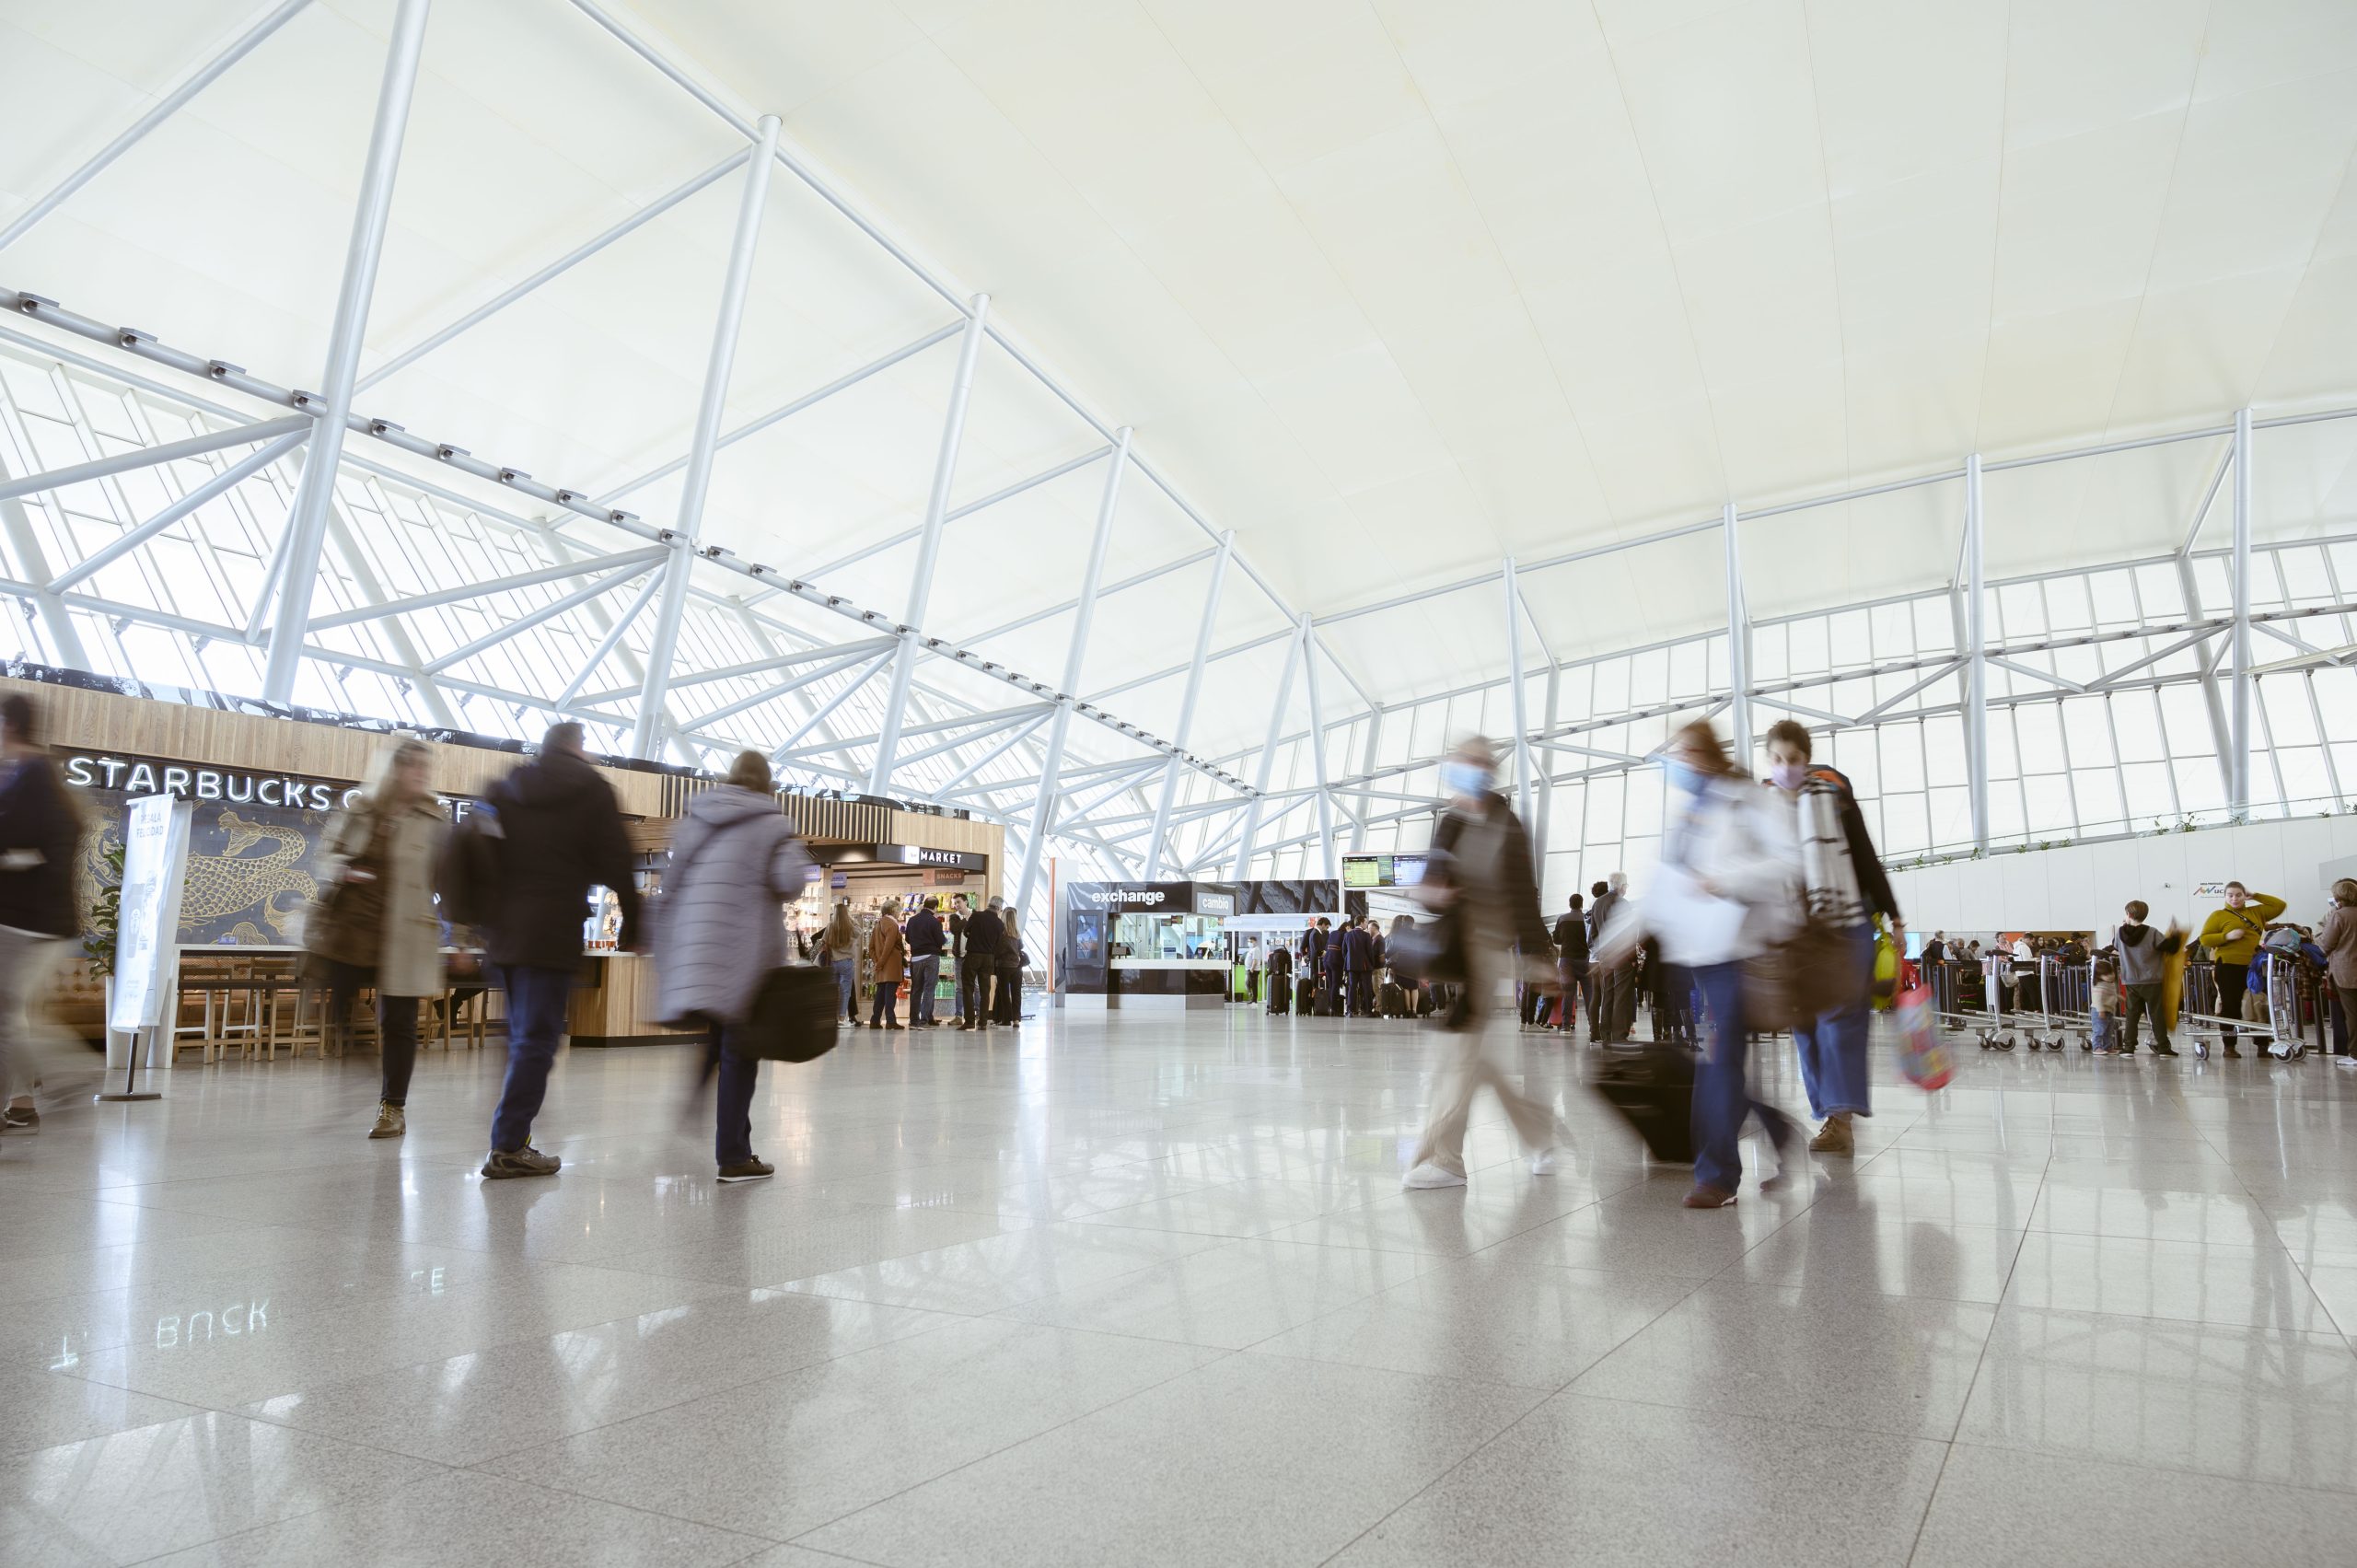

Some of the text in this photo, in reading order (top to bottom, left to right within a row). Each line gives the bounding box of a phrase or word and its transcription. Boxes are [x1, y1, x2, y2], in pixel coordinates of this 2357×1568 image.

[66, 756, 332, 811] STARBUCKS
[920, 851, 962, 865] MARKET
[936, 872, 962, 880] SNACKS
[1091, 889, 1166, 905] exchange
[1202, 896, 1229, 910] cambio
